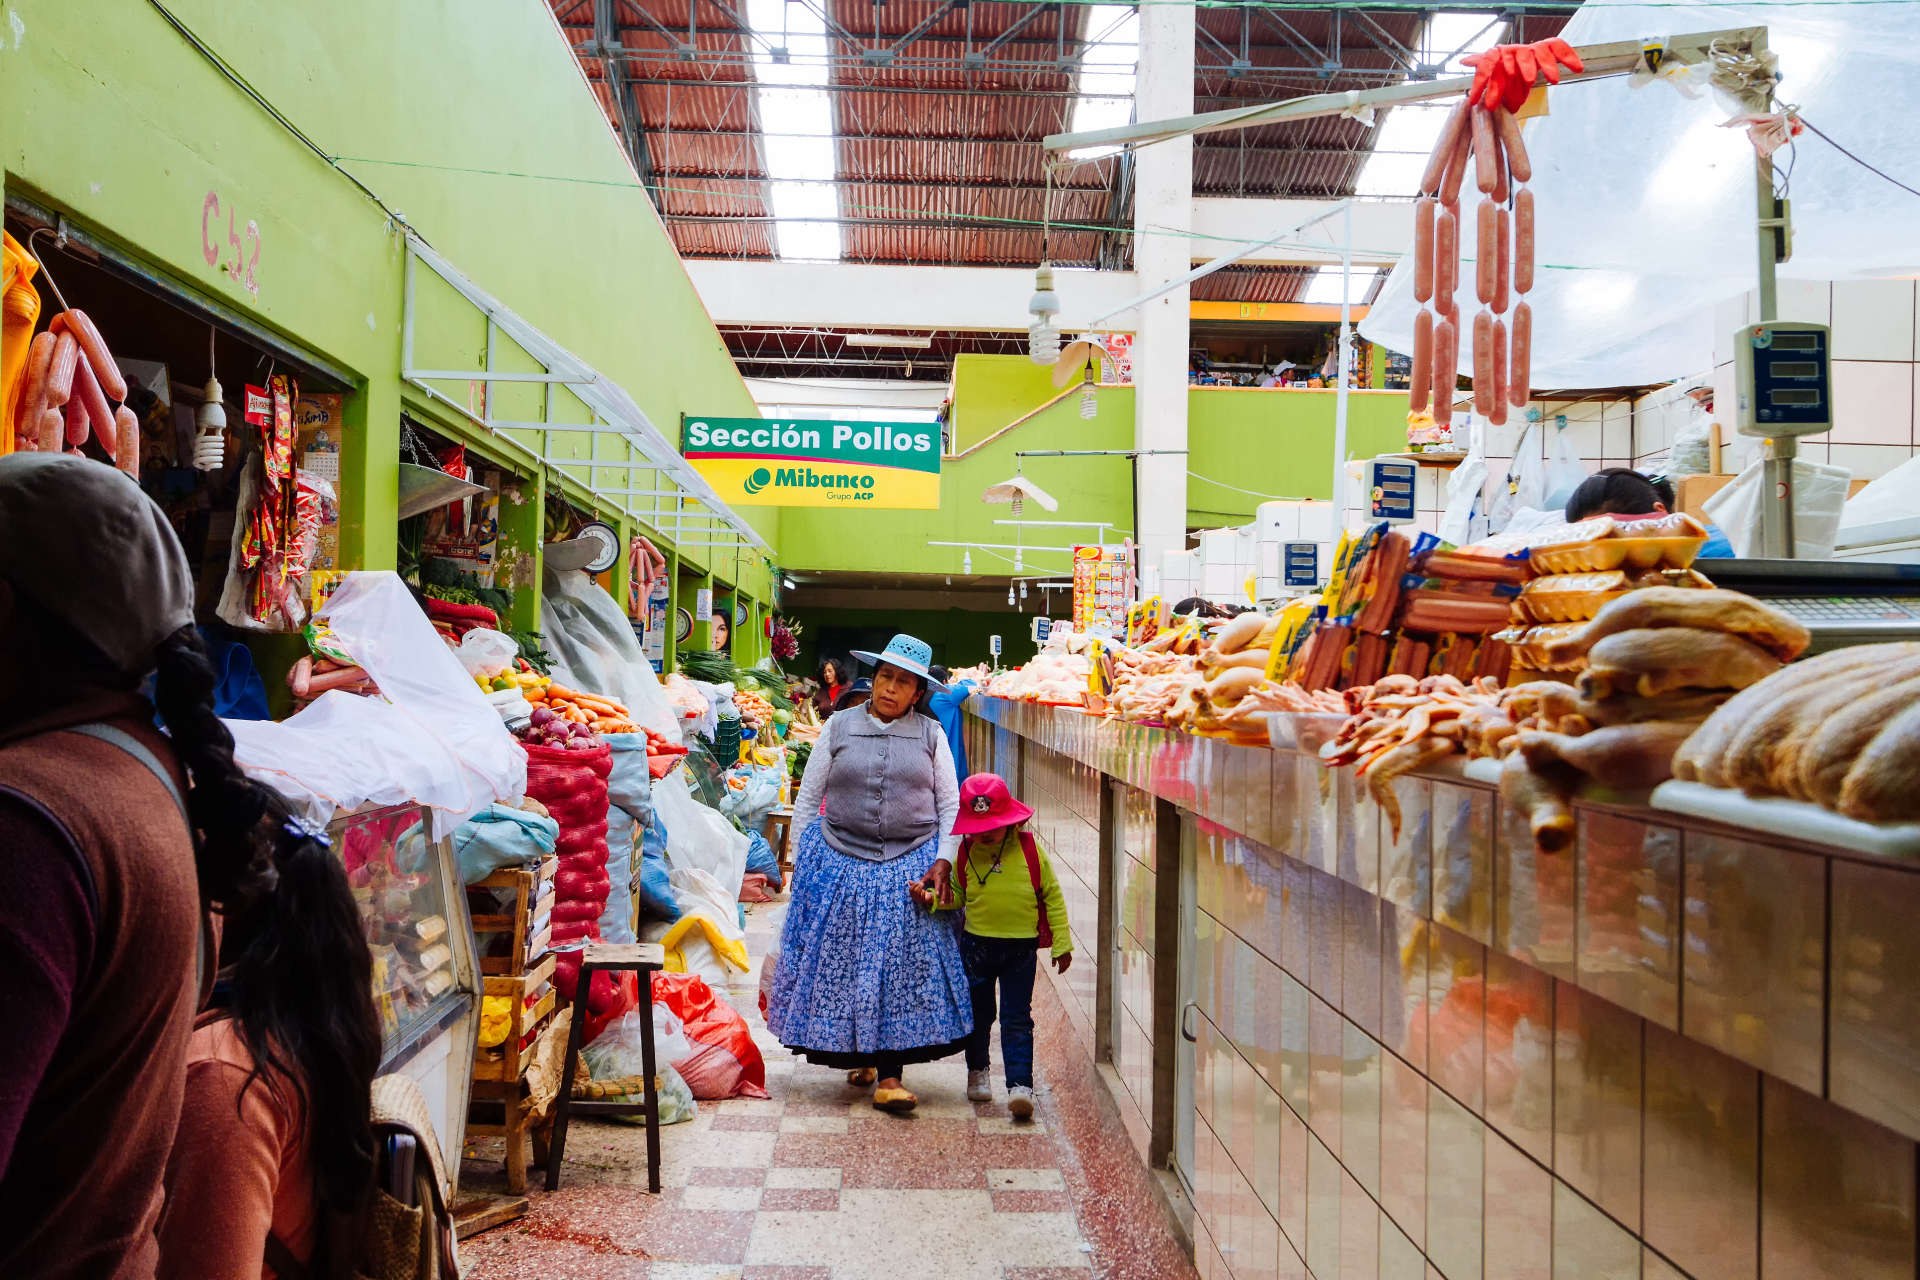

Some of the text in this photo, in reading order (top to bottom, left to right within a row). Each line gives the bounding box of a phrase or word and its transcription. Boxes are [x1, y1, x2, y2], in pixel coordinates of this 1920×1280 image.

[689, 422, 931, 451] Sección Pollos
[775, 469, 875, 489] Mibanco
[826, 491, 852, 501] Grupo
